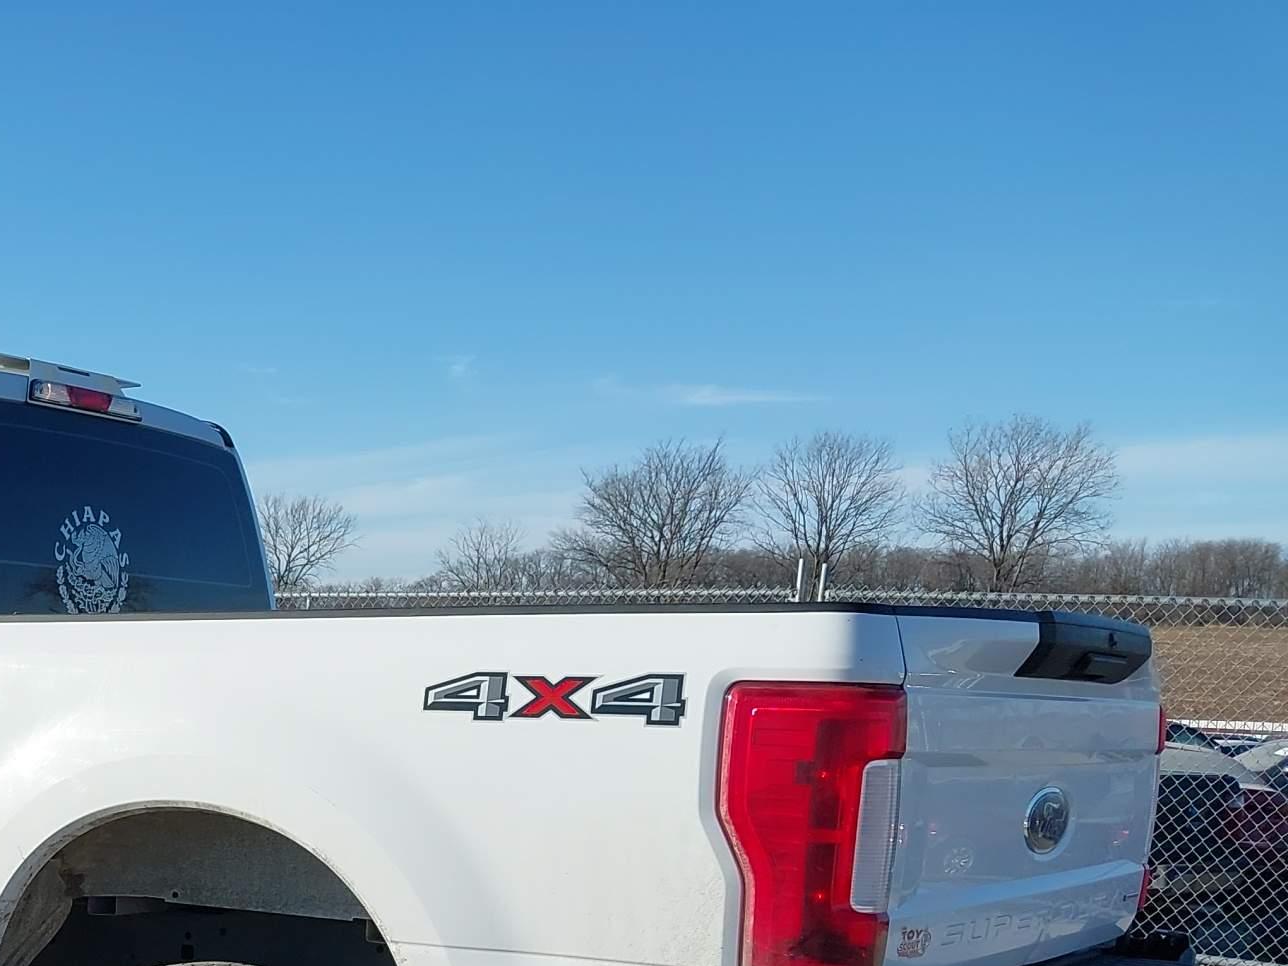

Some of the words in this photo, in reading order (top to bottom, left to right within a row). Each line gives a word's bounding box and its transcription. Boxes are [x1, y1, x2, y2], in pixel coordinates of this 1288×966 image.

[54, 505, 130, 568] CHIAPAS
[422, 671, 687, 726] 4X4
[901, 927, 923, 940] TOY
